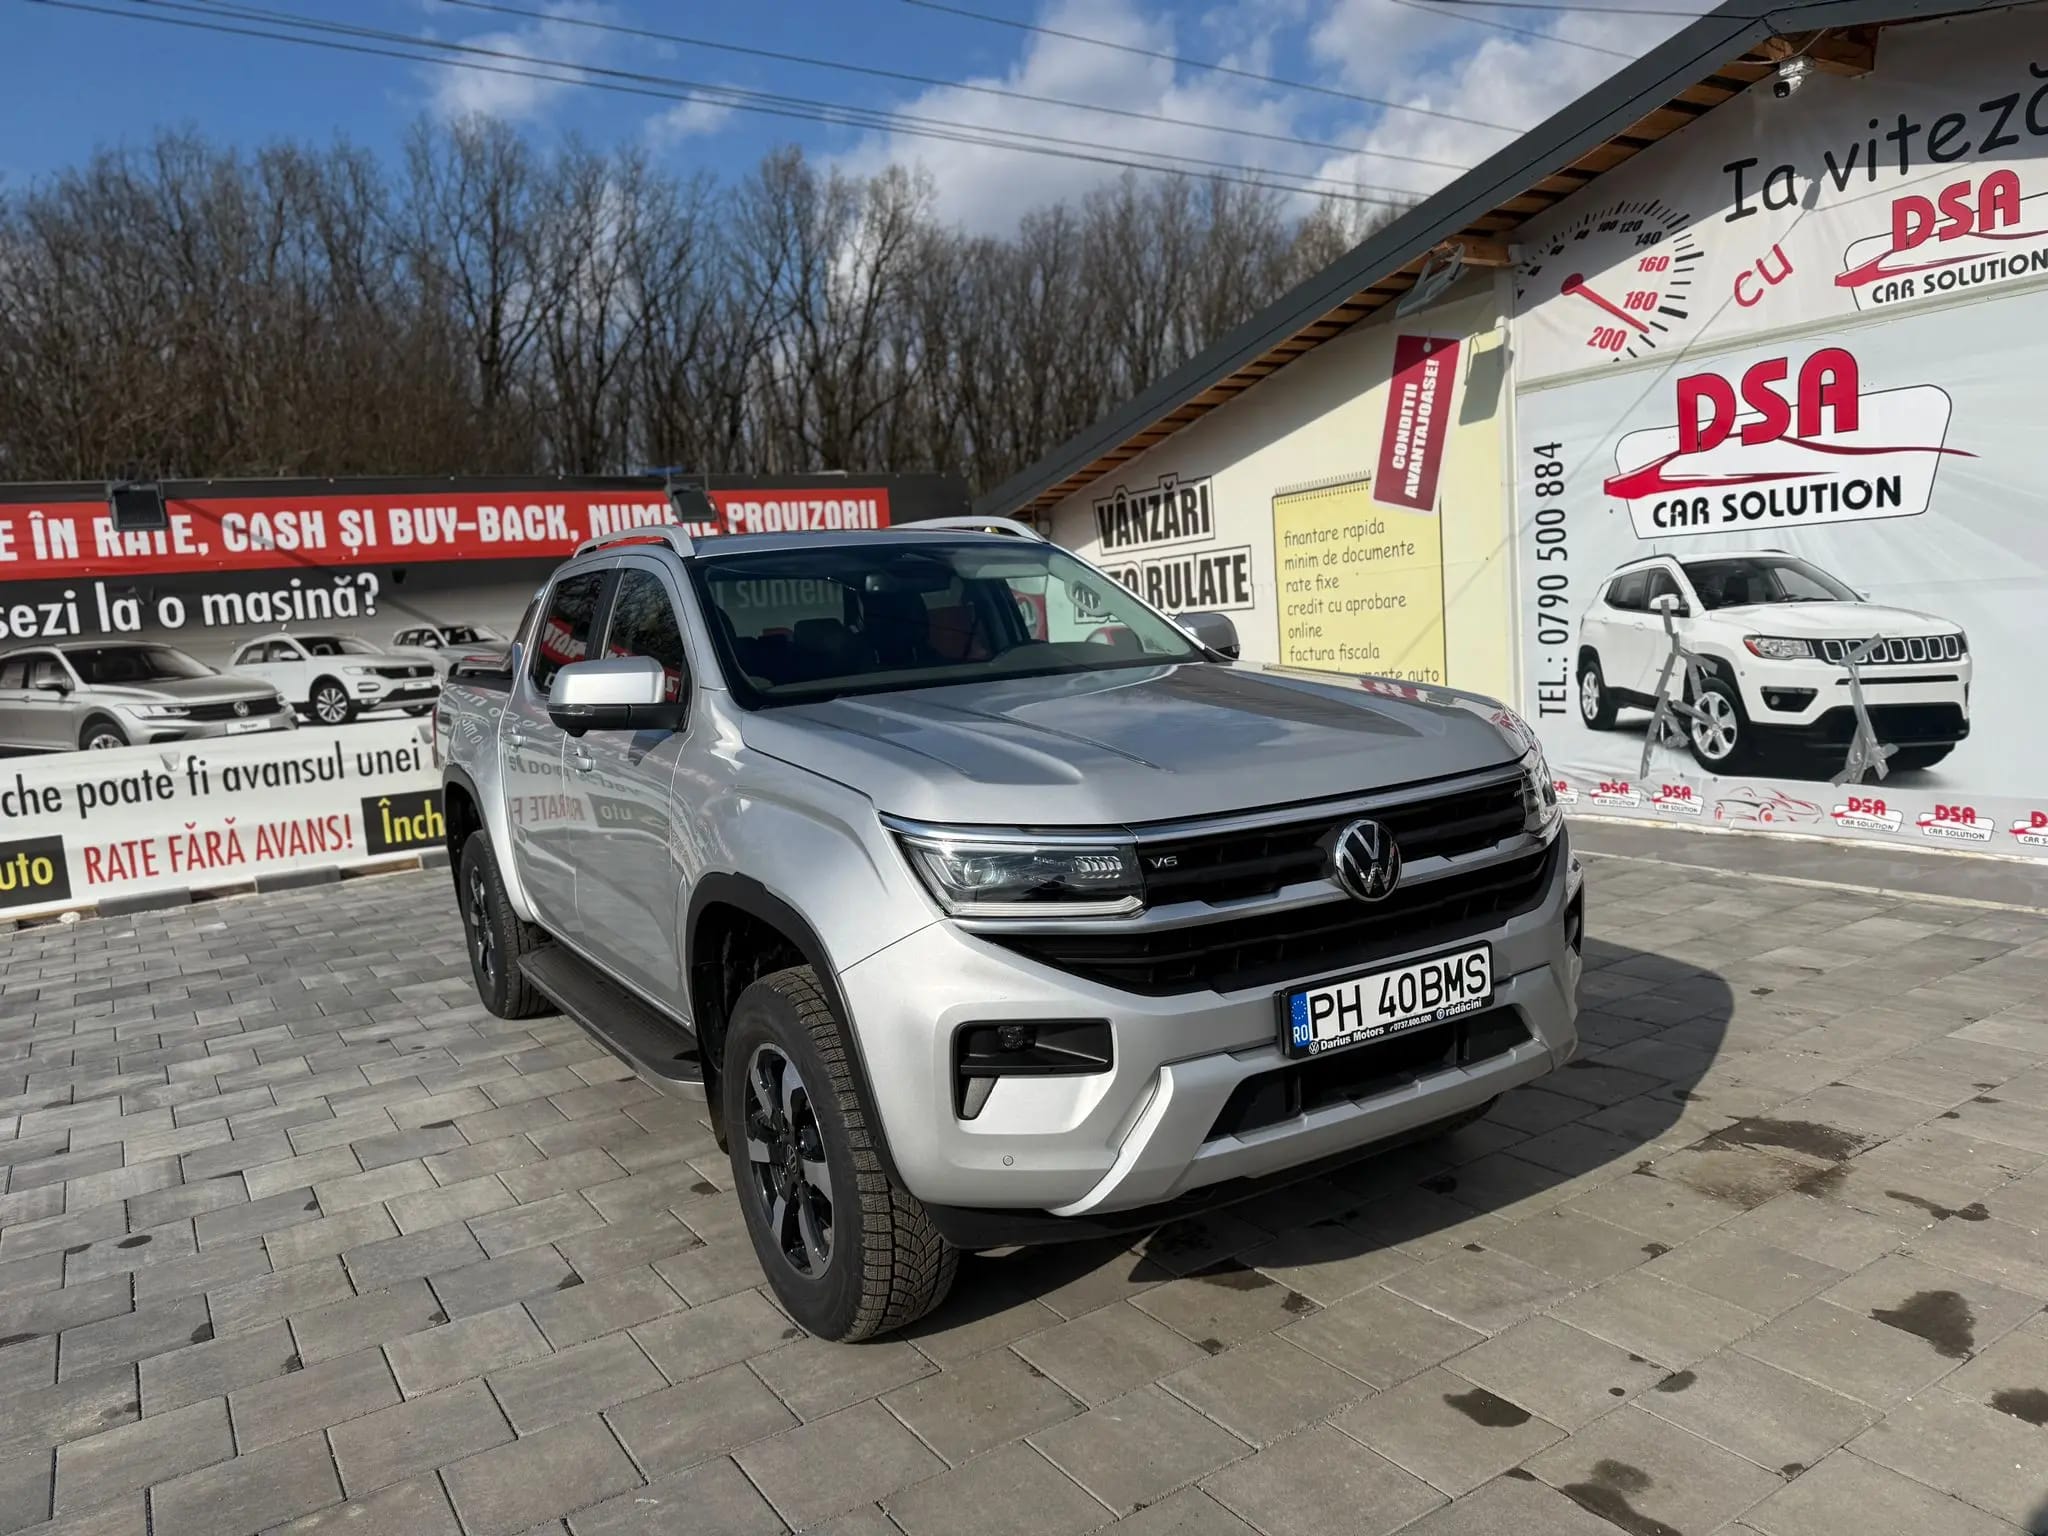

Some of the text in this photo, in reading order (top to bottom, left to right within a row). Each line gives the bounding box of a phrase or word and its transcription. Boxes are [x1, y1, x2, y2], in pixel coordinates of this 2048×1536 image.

[1723, 157, 1798, 223] Ia
[1892, 169, 2021, 251] DSA
[1618, 219, 1644, 234] 120
[1634, 231, 1663, 246] 140
[1637, 255, 1670, 273] 160
[1733, 243, 1793, 307] cu
[1623, 291, 1659, 312] 180
[1871, 279, 1915, 304] CAR
[1586, 326, 1628, 352] 200
[1677, 347, 1859, 456] DSA
[1404, 358, 1440, 500] AVANTAJOASE!
[1533, 441, 1564, 498] 884
[1097, 480, 1210, 549] VÂNZĂRI
[1653, 475, 1902, 529] CAR SOLUTION
[28, 510, 80, 561] ÎN
[222, 509, 326, 553] CASH
[388, 504, 580, 547] BUY-BACK,
[1284, 517, 1386, 549] finantare rapida
[1535, 508, 1568, 561] 500
[1284, 539, 1416, 571] minim de documente
[1146, 553, 1250, 610] RULATE
[1286, 573, 1340, 593] rate fixe
[94, 581, 142, 633] la
[157, 596, 187, 629] o
[1287, 592, 1407, 617] credit cu aprobare
[1537, 574, 1569, 645] 0790
[1288, 621, 1324, 640] online
[1290, 642, 1381, 663] factura fiscala
[76, 769, 175, 820] poate
[186, 755, 210, 797] fi
[222, 740, 345, 792] avansul
[356, 738, 421, 777] unei
[1599, 782, 1630, 795] DSA
[1661, 784, 1692, 800] DSA
[1847, 797, 1886, 816] DSA
[1934, 804, 1976, 824] DSA
[1856, 820, 1894, 831] SOLUTION
[1928, 828, 1985, 840] CAR SOLUTION
[83, 813, 353, 885] RATE FĂRĂ AVANS!
[2023, 836, 2039, 844] CAR
[1147, 855, 1178, 869] V6
[1309, 984, 1363, 1040] PH
[1293, 1023, 1309, 1044] RO
[1320, 1034, 1352, 1051] Darius
[1353, 1025, 1385, 1042] Motors
